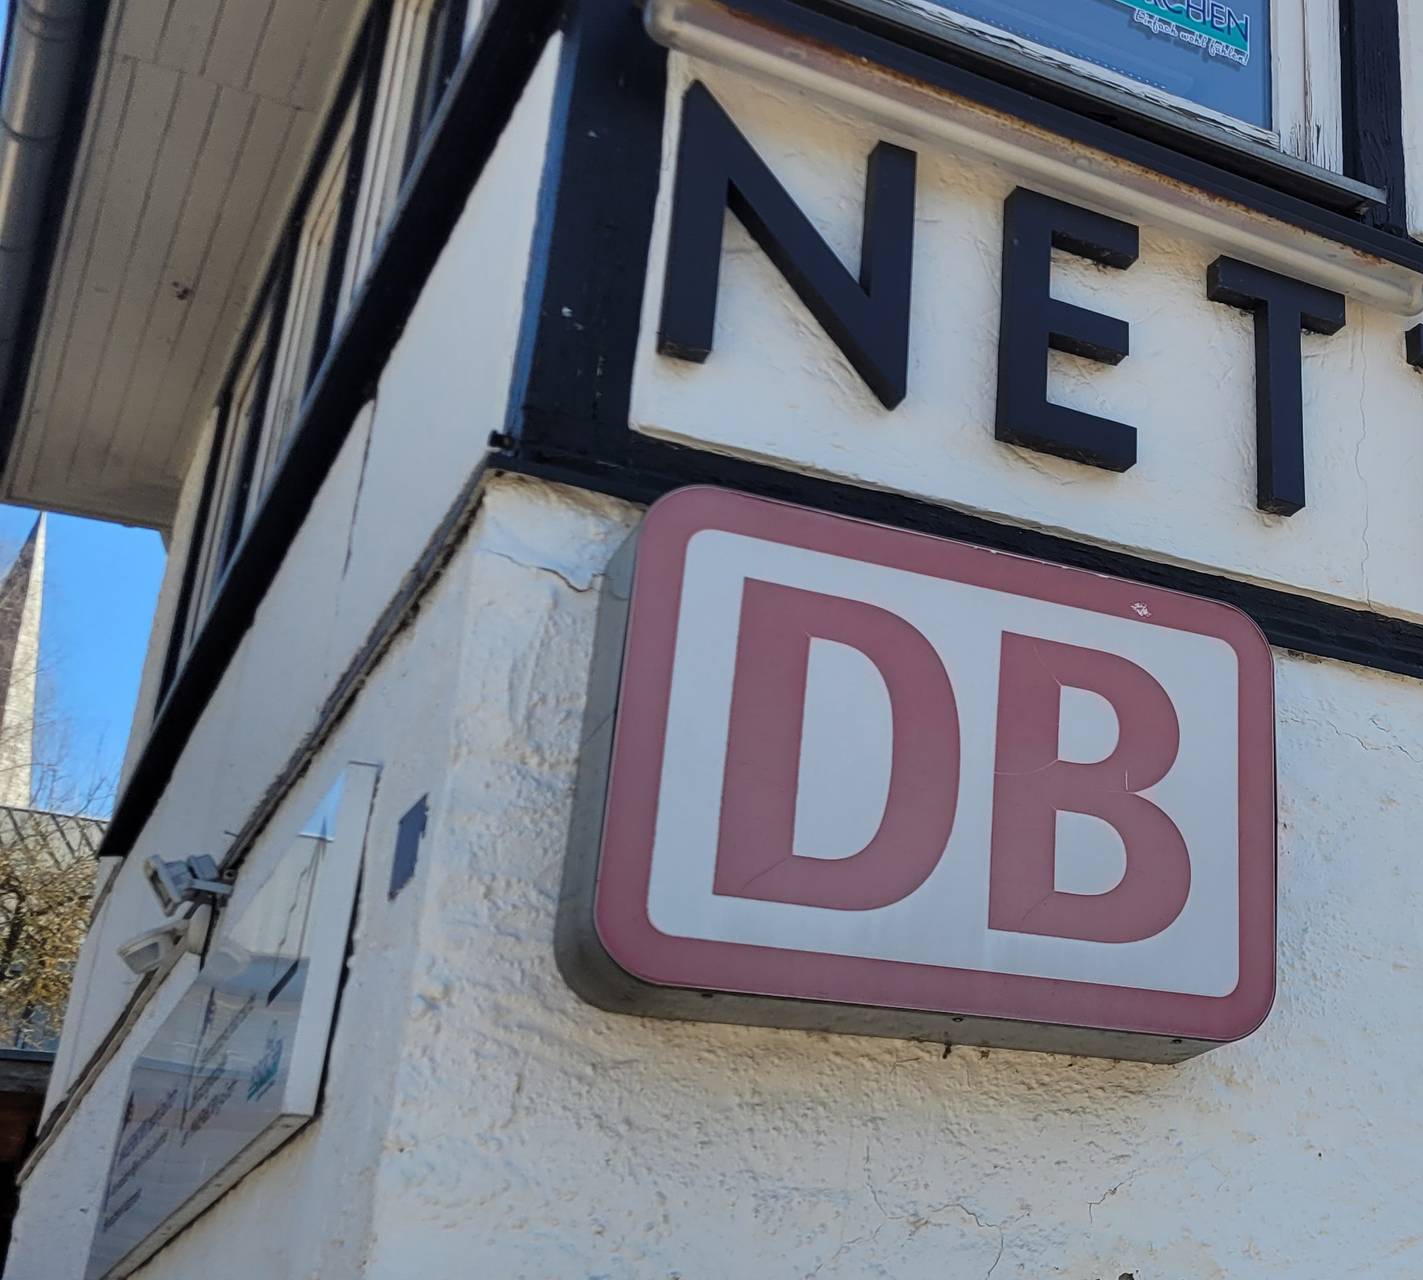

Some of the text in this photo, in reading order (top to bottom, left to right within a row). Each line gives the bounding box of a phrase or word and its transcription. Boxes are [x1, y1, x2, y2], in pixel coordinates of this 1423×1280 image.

[1134, 8, 1249, 66] Einfach wohl fühlen!
[712, 576, 1191, 944] DB
